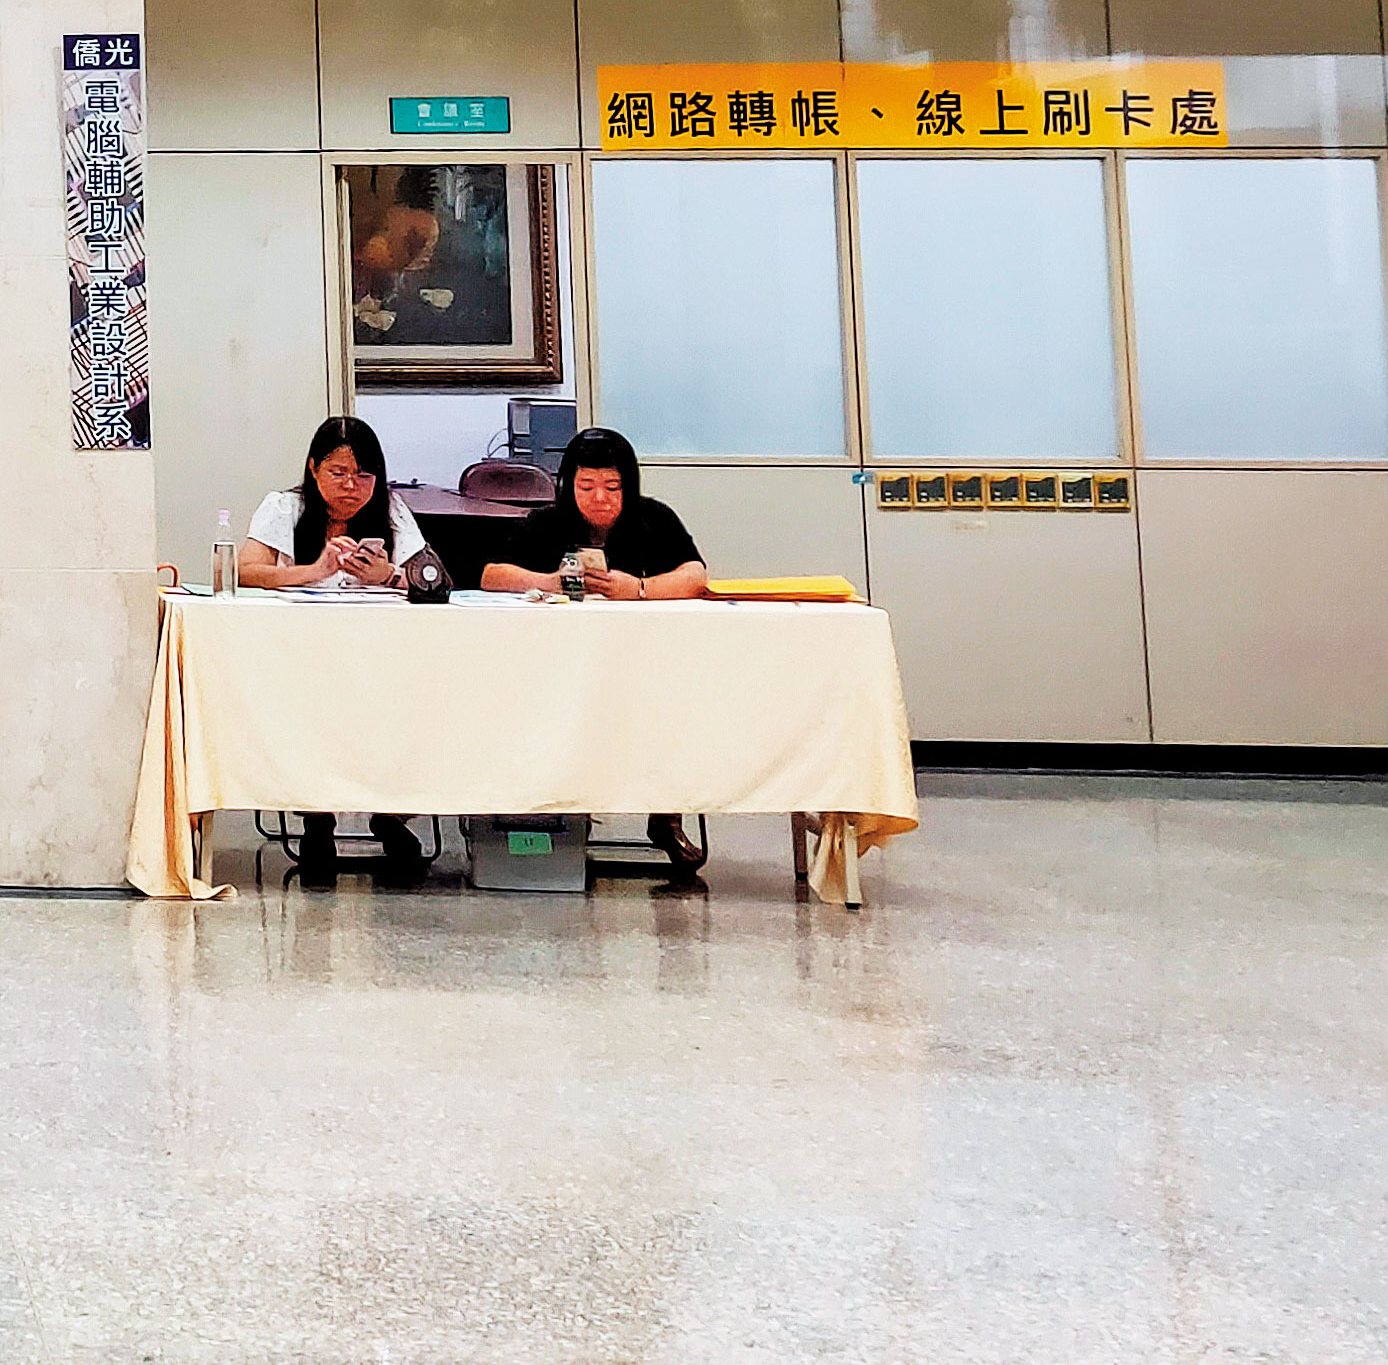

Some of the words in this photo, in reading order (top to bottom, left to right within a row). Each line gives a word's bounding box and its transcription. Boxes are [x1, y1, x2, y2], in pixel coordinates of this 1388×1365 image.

[72, 38, 134, 67] 僑光
[607, 89, 1220, 139] 網路轉帳、線上刷卡處
[84, 80, 131, 439] 電腦輔助工業設計系
